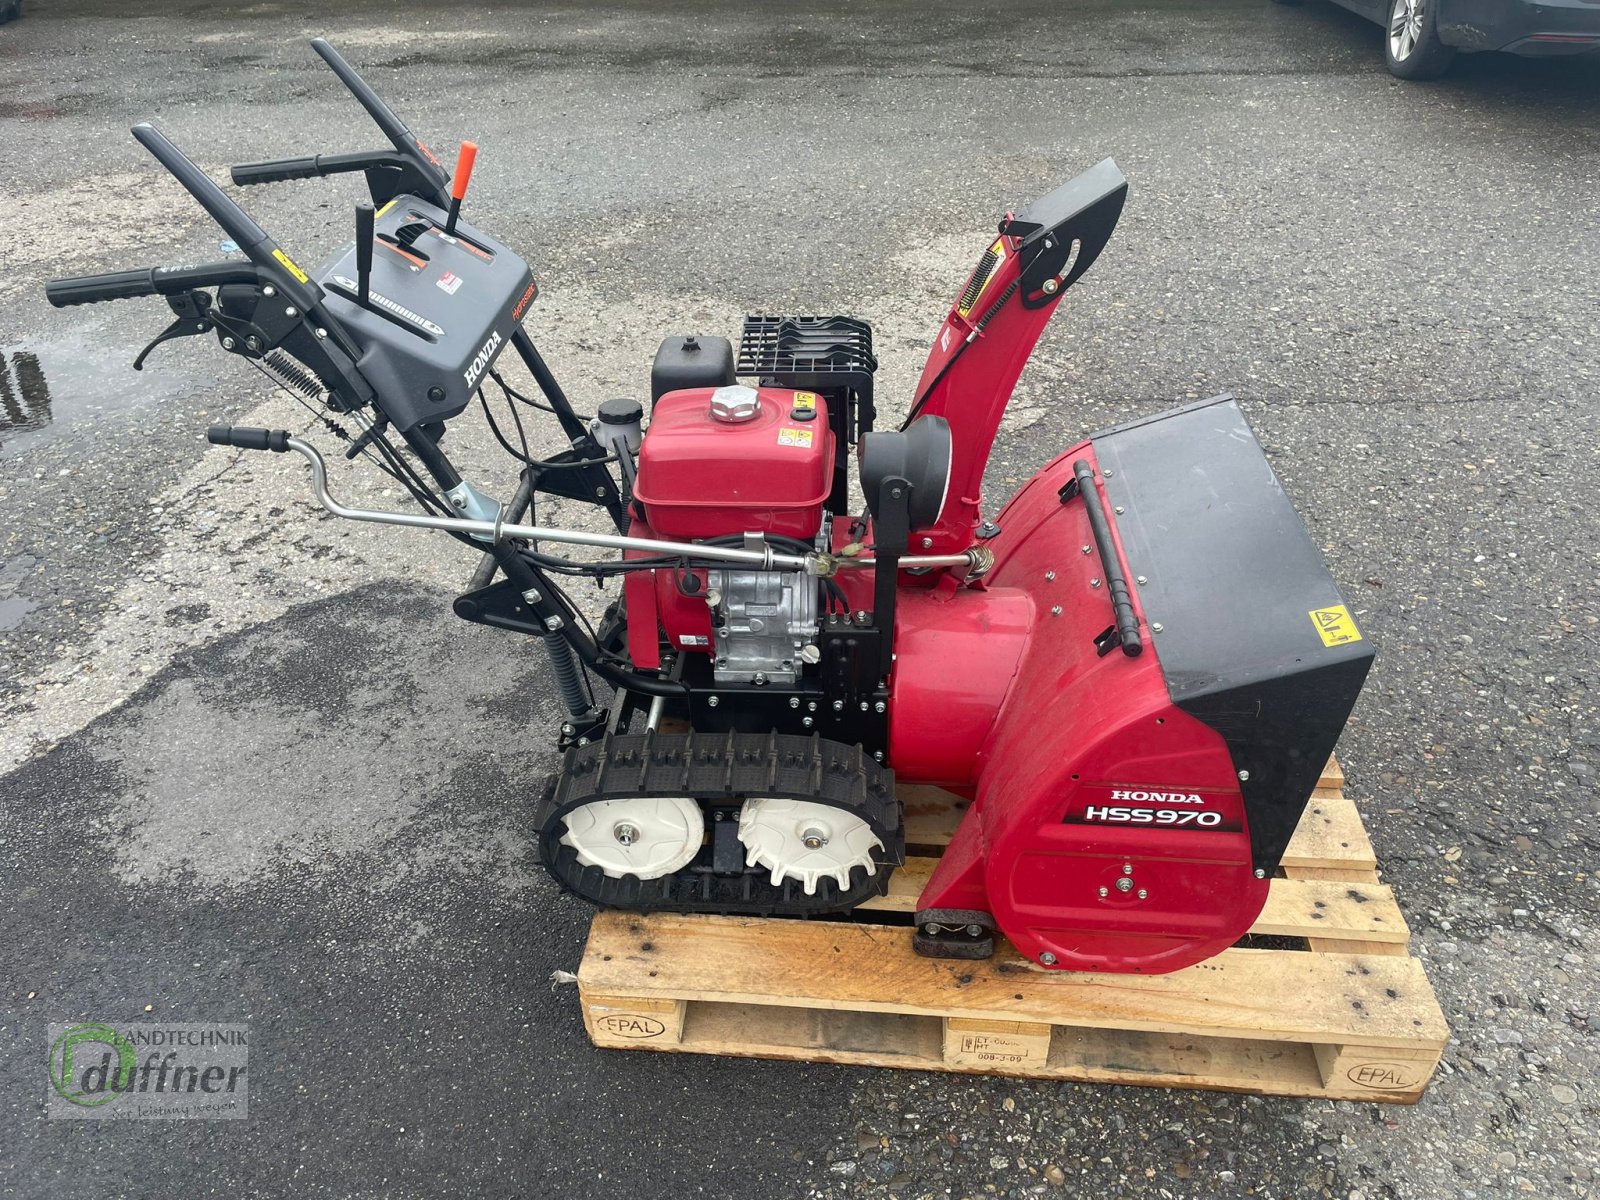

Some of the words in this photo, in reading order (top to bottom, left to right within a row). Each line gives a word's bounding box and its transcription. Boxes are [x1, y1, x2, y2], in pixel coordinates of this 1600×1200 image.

[463, 330, 502, 388] HONDA
[1111, 790, 1205, 804] HONDA
[1086, 806, 1222, 826] HSS970
[607, 1018, 655, 1034] EPAL
[1356, 1066, 1407, 1085] EPAL
